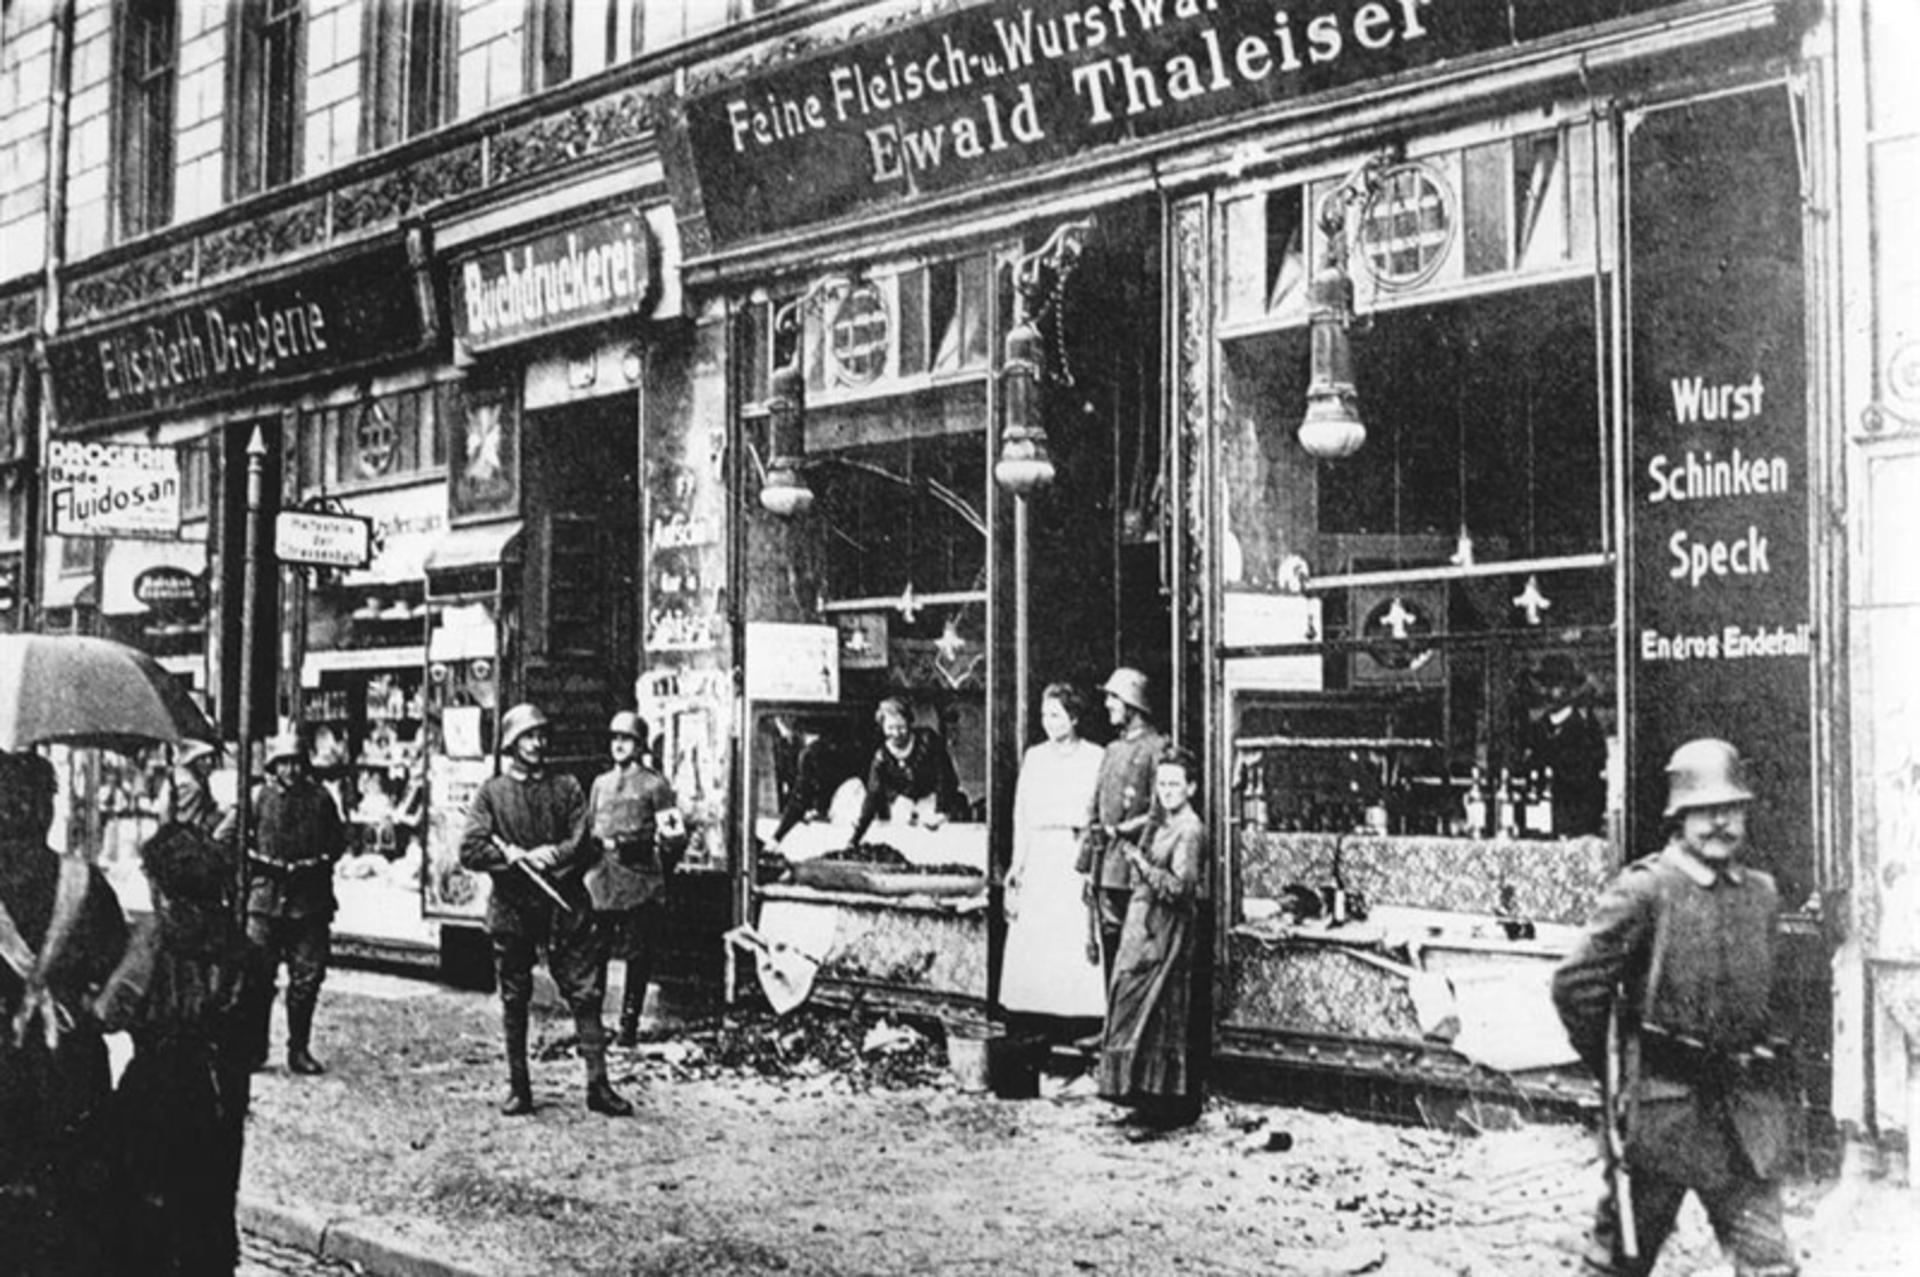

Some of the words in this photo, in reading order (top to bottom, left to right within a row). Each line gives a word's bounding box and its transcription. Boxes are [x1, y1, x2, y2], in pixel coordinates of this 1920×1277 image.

[727, 96, 826, 151] Feine
[993, 0, 1218, 71] Wurstwa
[864, 84, 1045, 183] Ewald
[1072, 0, 1429, 126] Thaleiser
[462, 222, 642, 335] Buchdruckerei
[98, 312, 206, 400] Elisabeth
[205, 291, 328, 373] Drogerie
[1670, 374, 1765, 425] Wurst
[51, 478, 176, 534] Fluidosan
[1647, 447, 1788, 503] Schinken
[1669, 526, 1770, 588] Speck
[1723, 624, 1810, 658] Endetail
